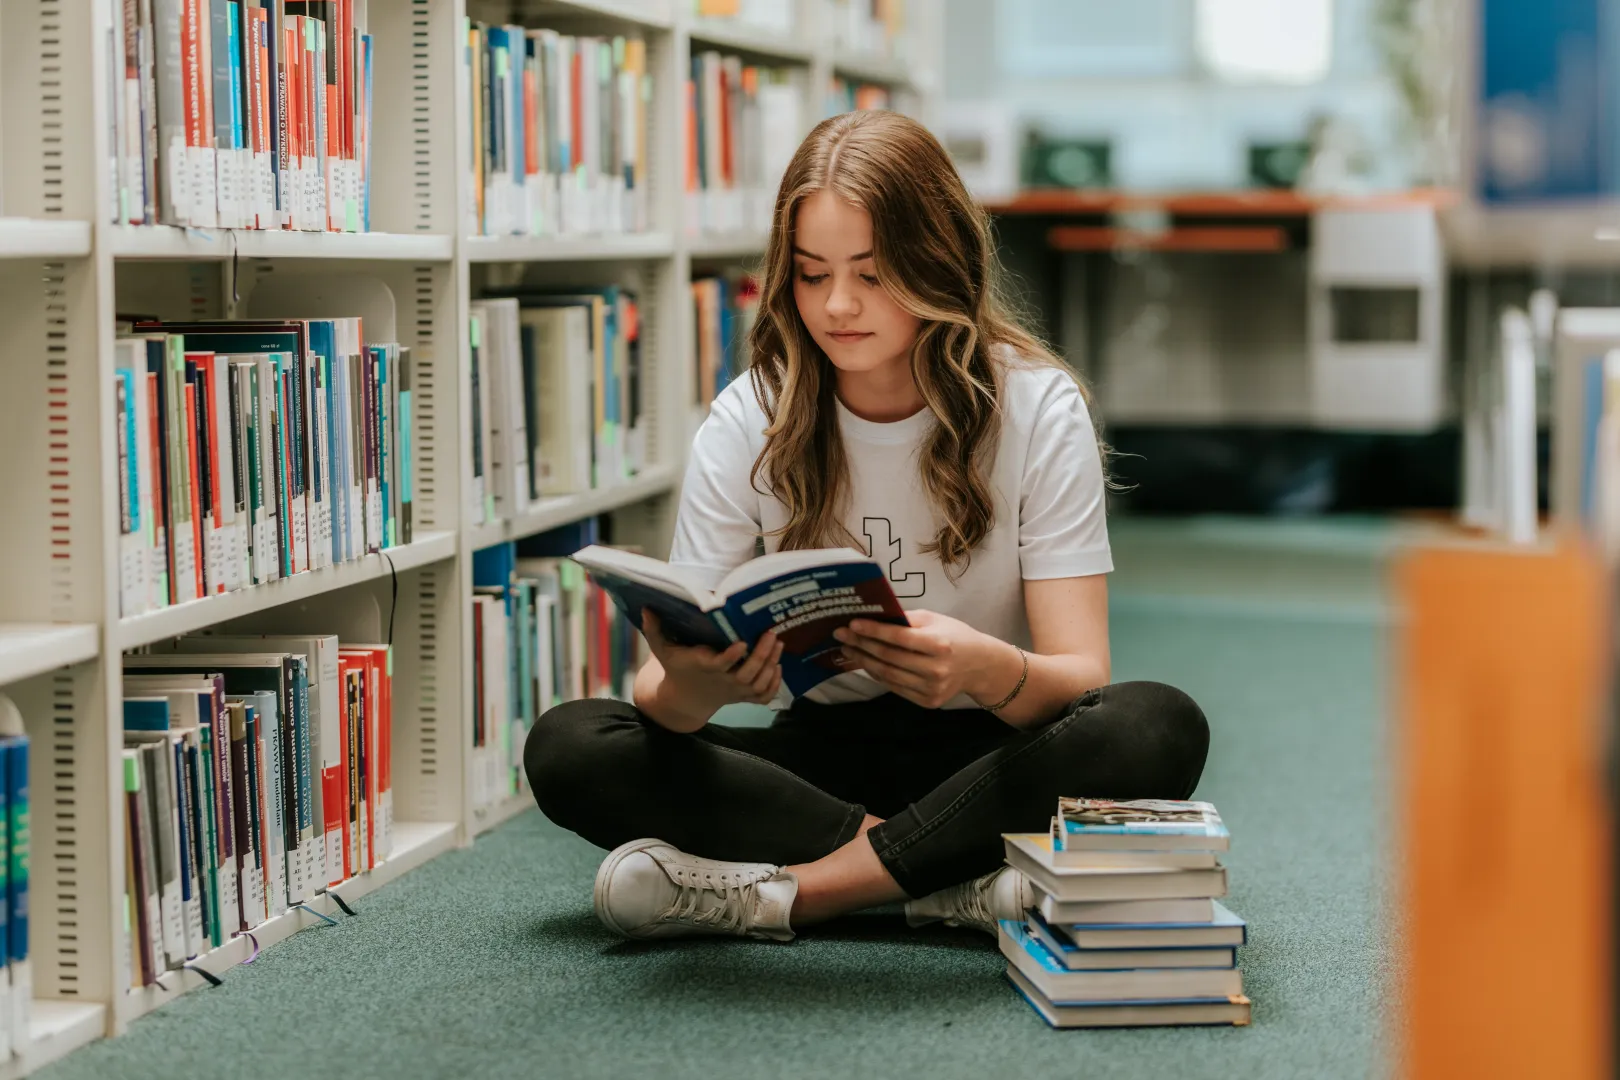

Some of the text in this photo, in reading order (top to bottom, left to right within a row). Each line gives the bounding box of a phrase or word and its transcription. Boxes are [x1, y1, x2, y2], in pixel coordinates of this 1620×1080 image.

[252, 17, 261, 81] Wykroczenia
[768, 587, 855, 614] CEL PUBLICZNY
[772, 596, 863, 622] W GOSPODARCE
[271, 728, 279, 773] PRAWO
[290, 728, 298, 799] budowlane
